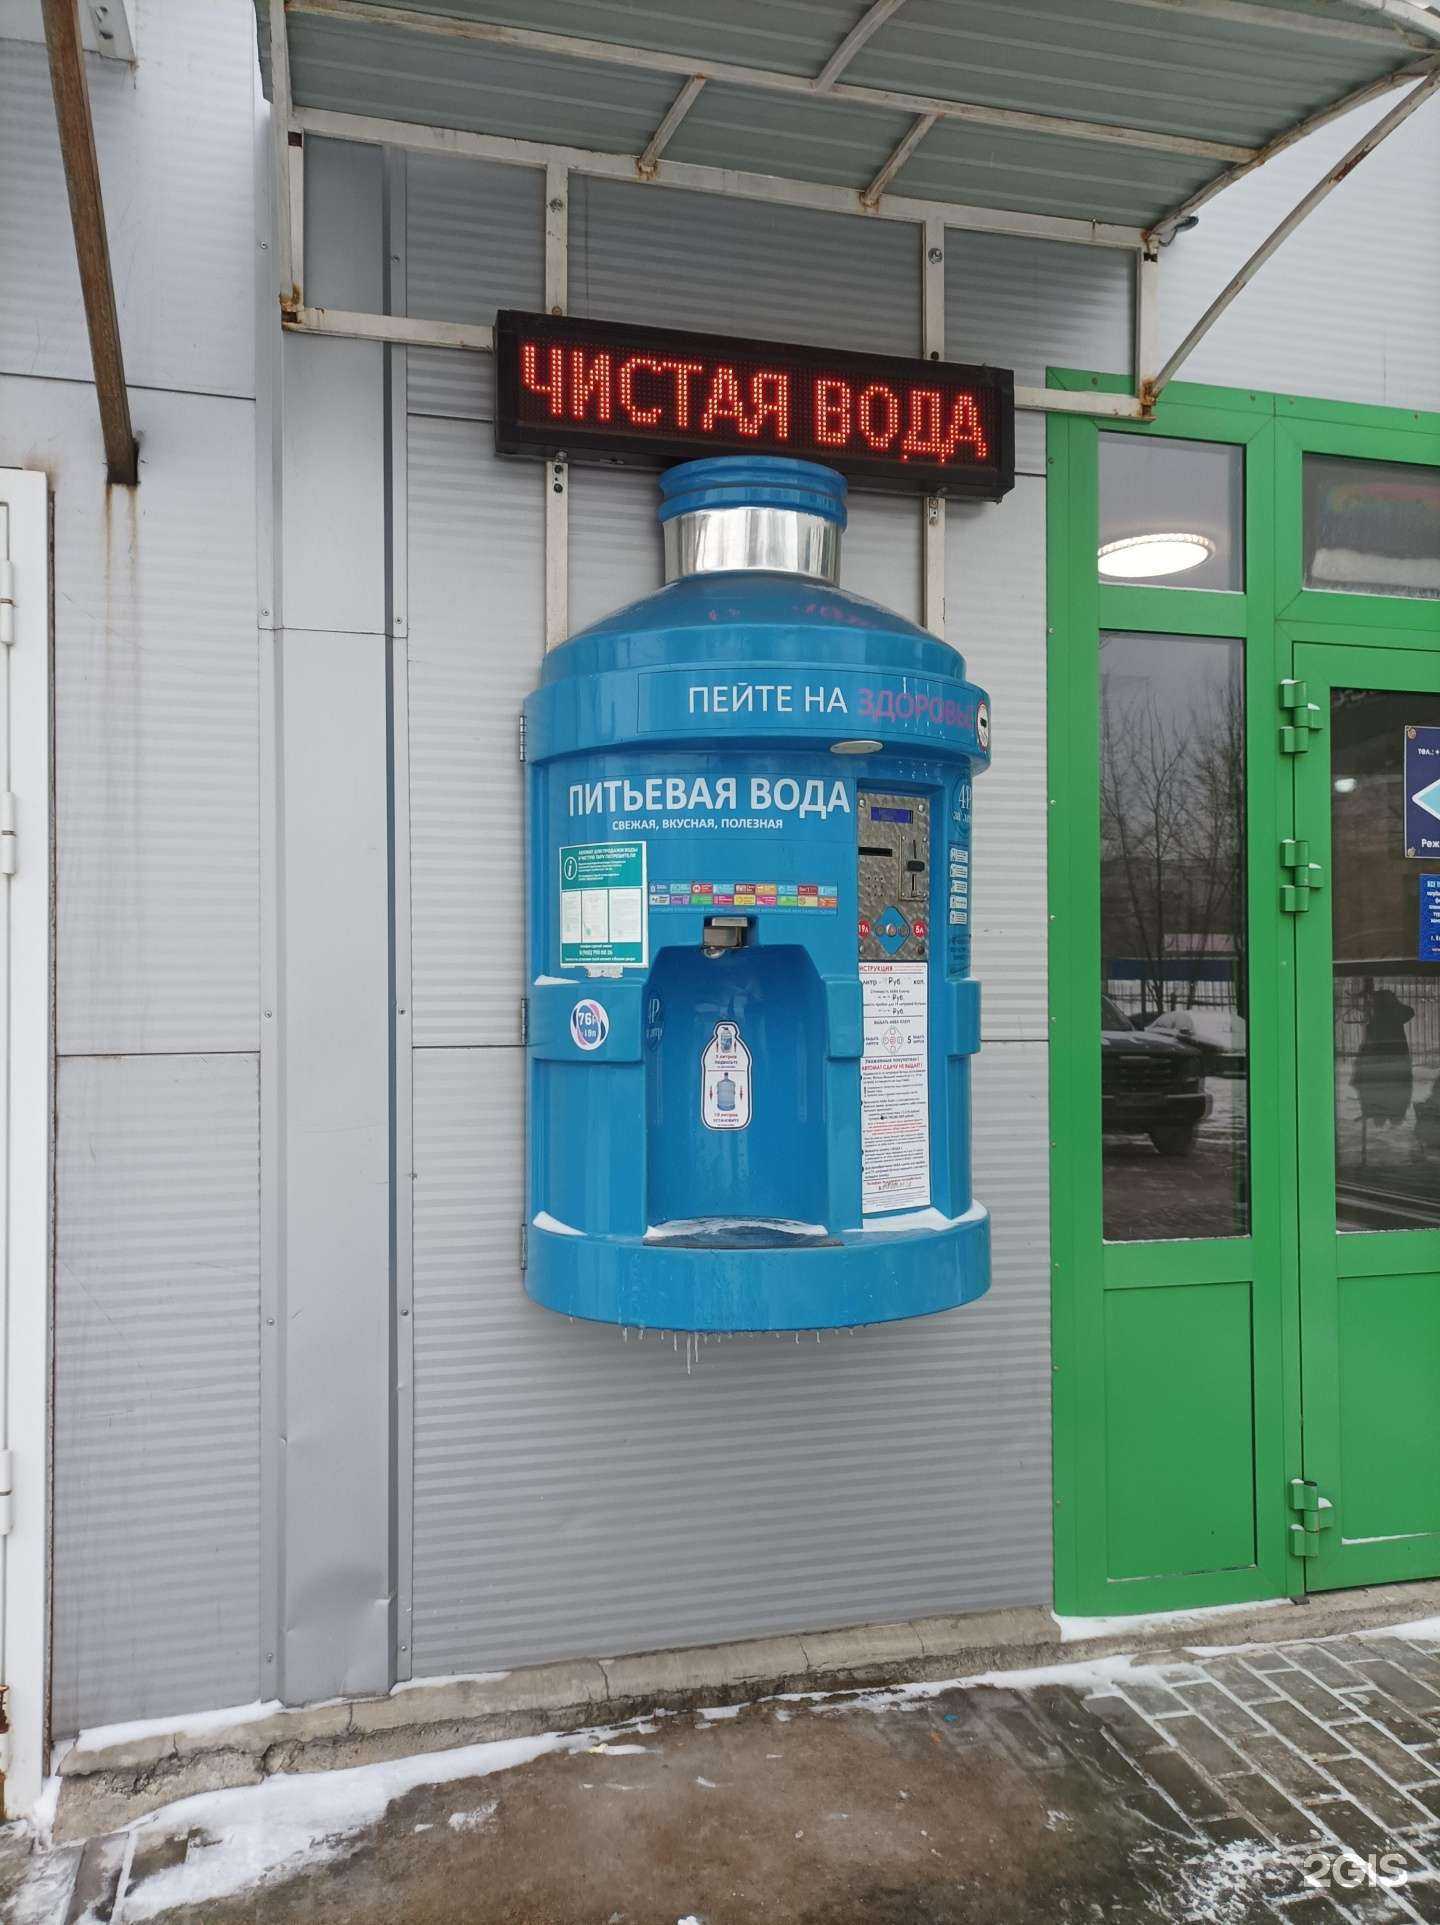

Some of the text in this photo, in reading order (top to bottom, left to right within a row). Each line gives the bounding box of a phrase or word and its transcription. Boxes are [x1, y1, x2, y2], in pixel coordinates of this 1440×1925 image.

[524, 344, 988, 464] ЧИСТАЯ ВОДА
[688, 682, 793, 714] ПЕЙТЕ
[804, 686, 848, 714] НА
[569, 777, 851, 820] ПИТЬЕВАЯ ВОДА
[612, 818, 783, 831] СВЕЖАЯ, ВКУСНАЯ, ПОЛЕЗНАЯ
